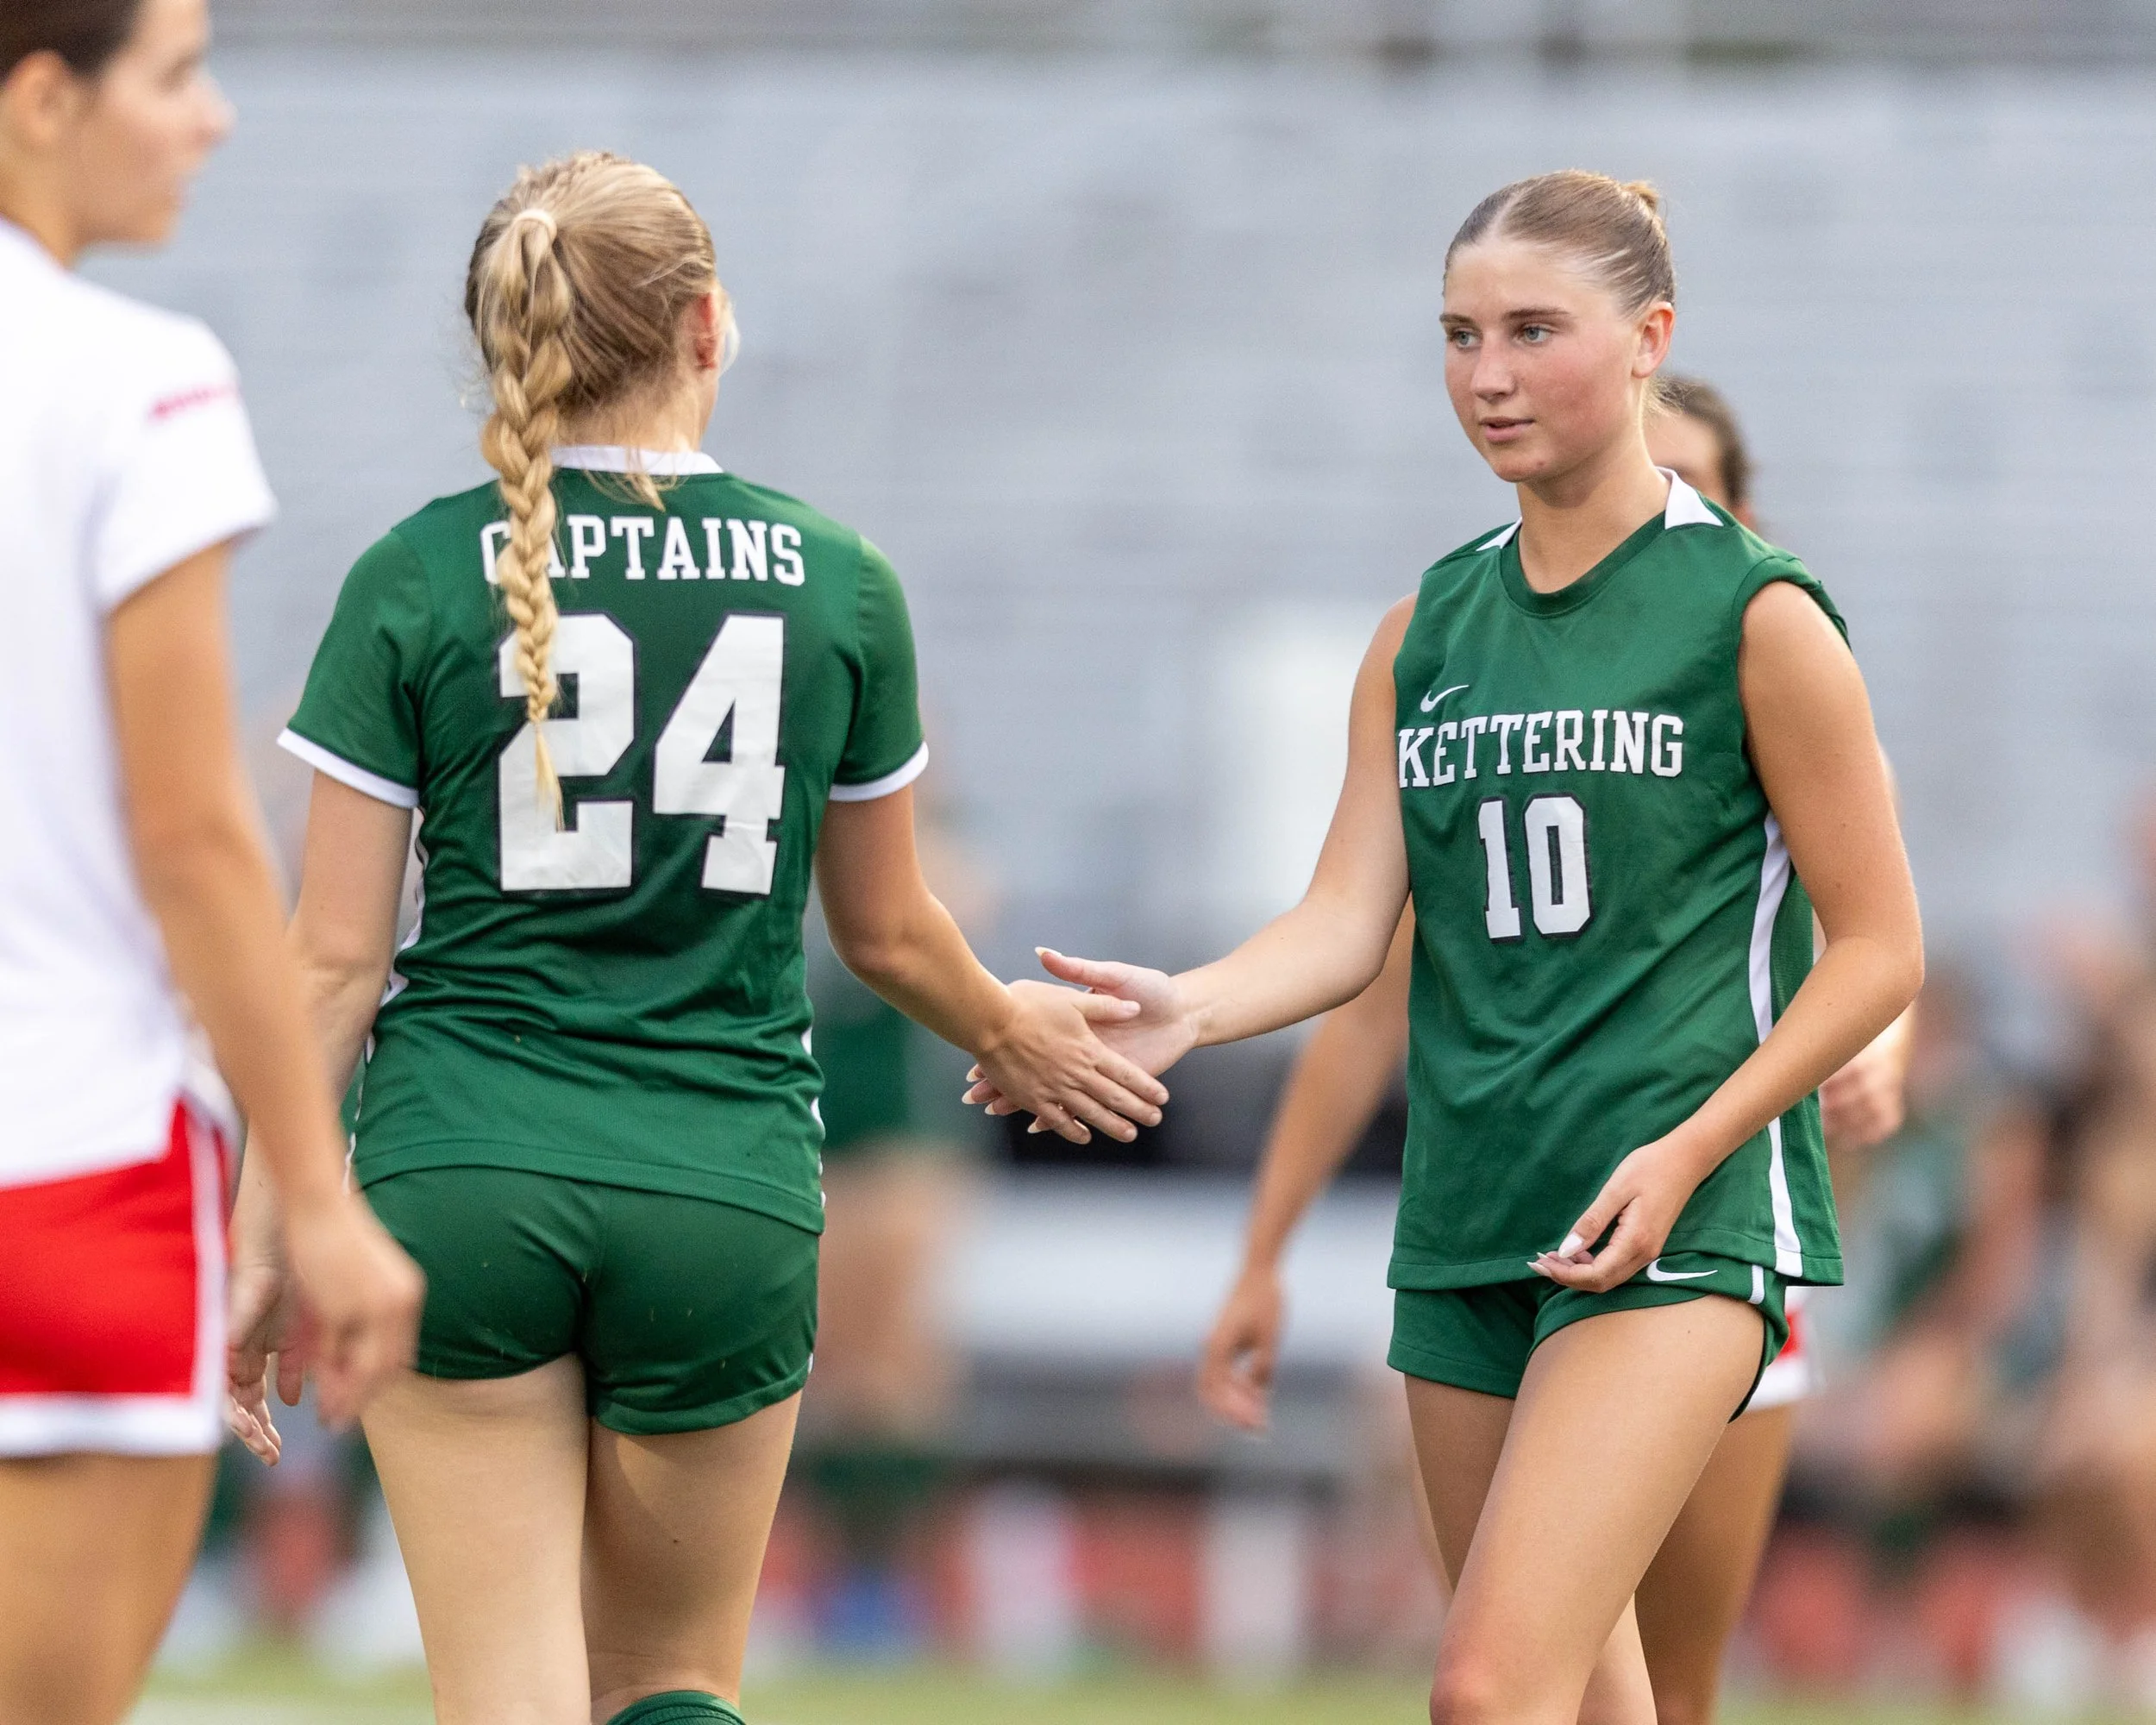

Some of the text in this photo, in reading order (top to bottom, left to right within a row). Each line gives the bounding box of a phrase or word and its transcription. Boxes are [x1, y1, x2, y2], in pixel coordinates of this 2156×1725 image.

[497, 612, 786, 895] 24
[1397, 709, 1684, 788] KETTERING
[1477, 794, 1592, 941] 10
